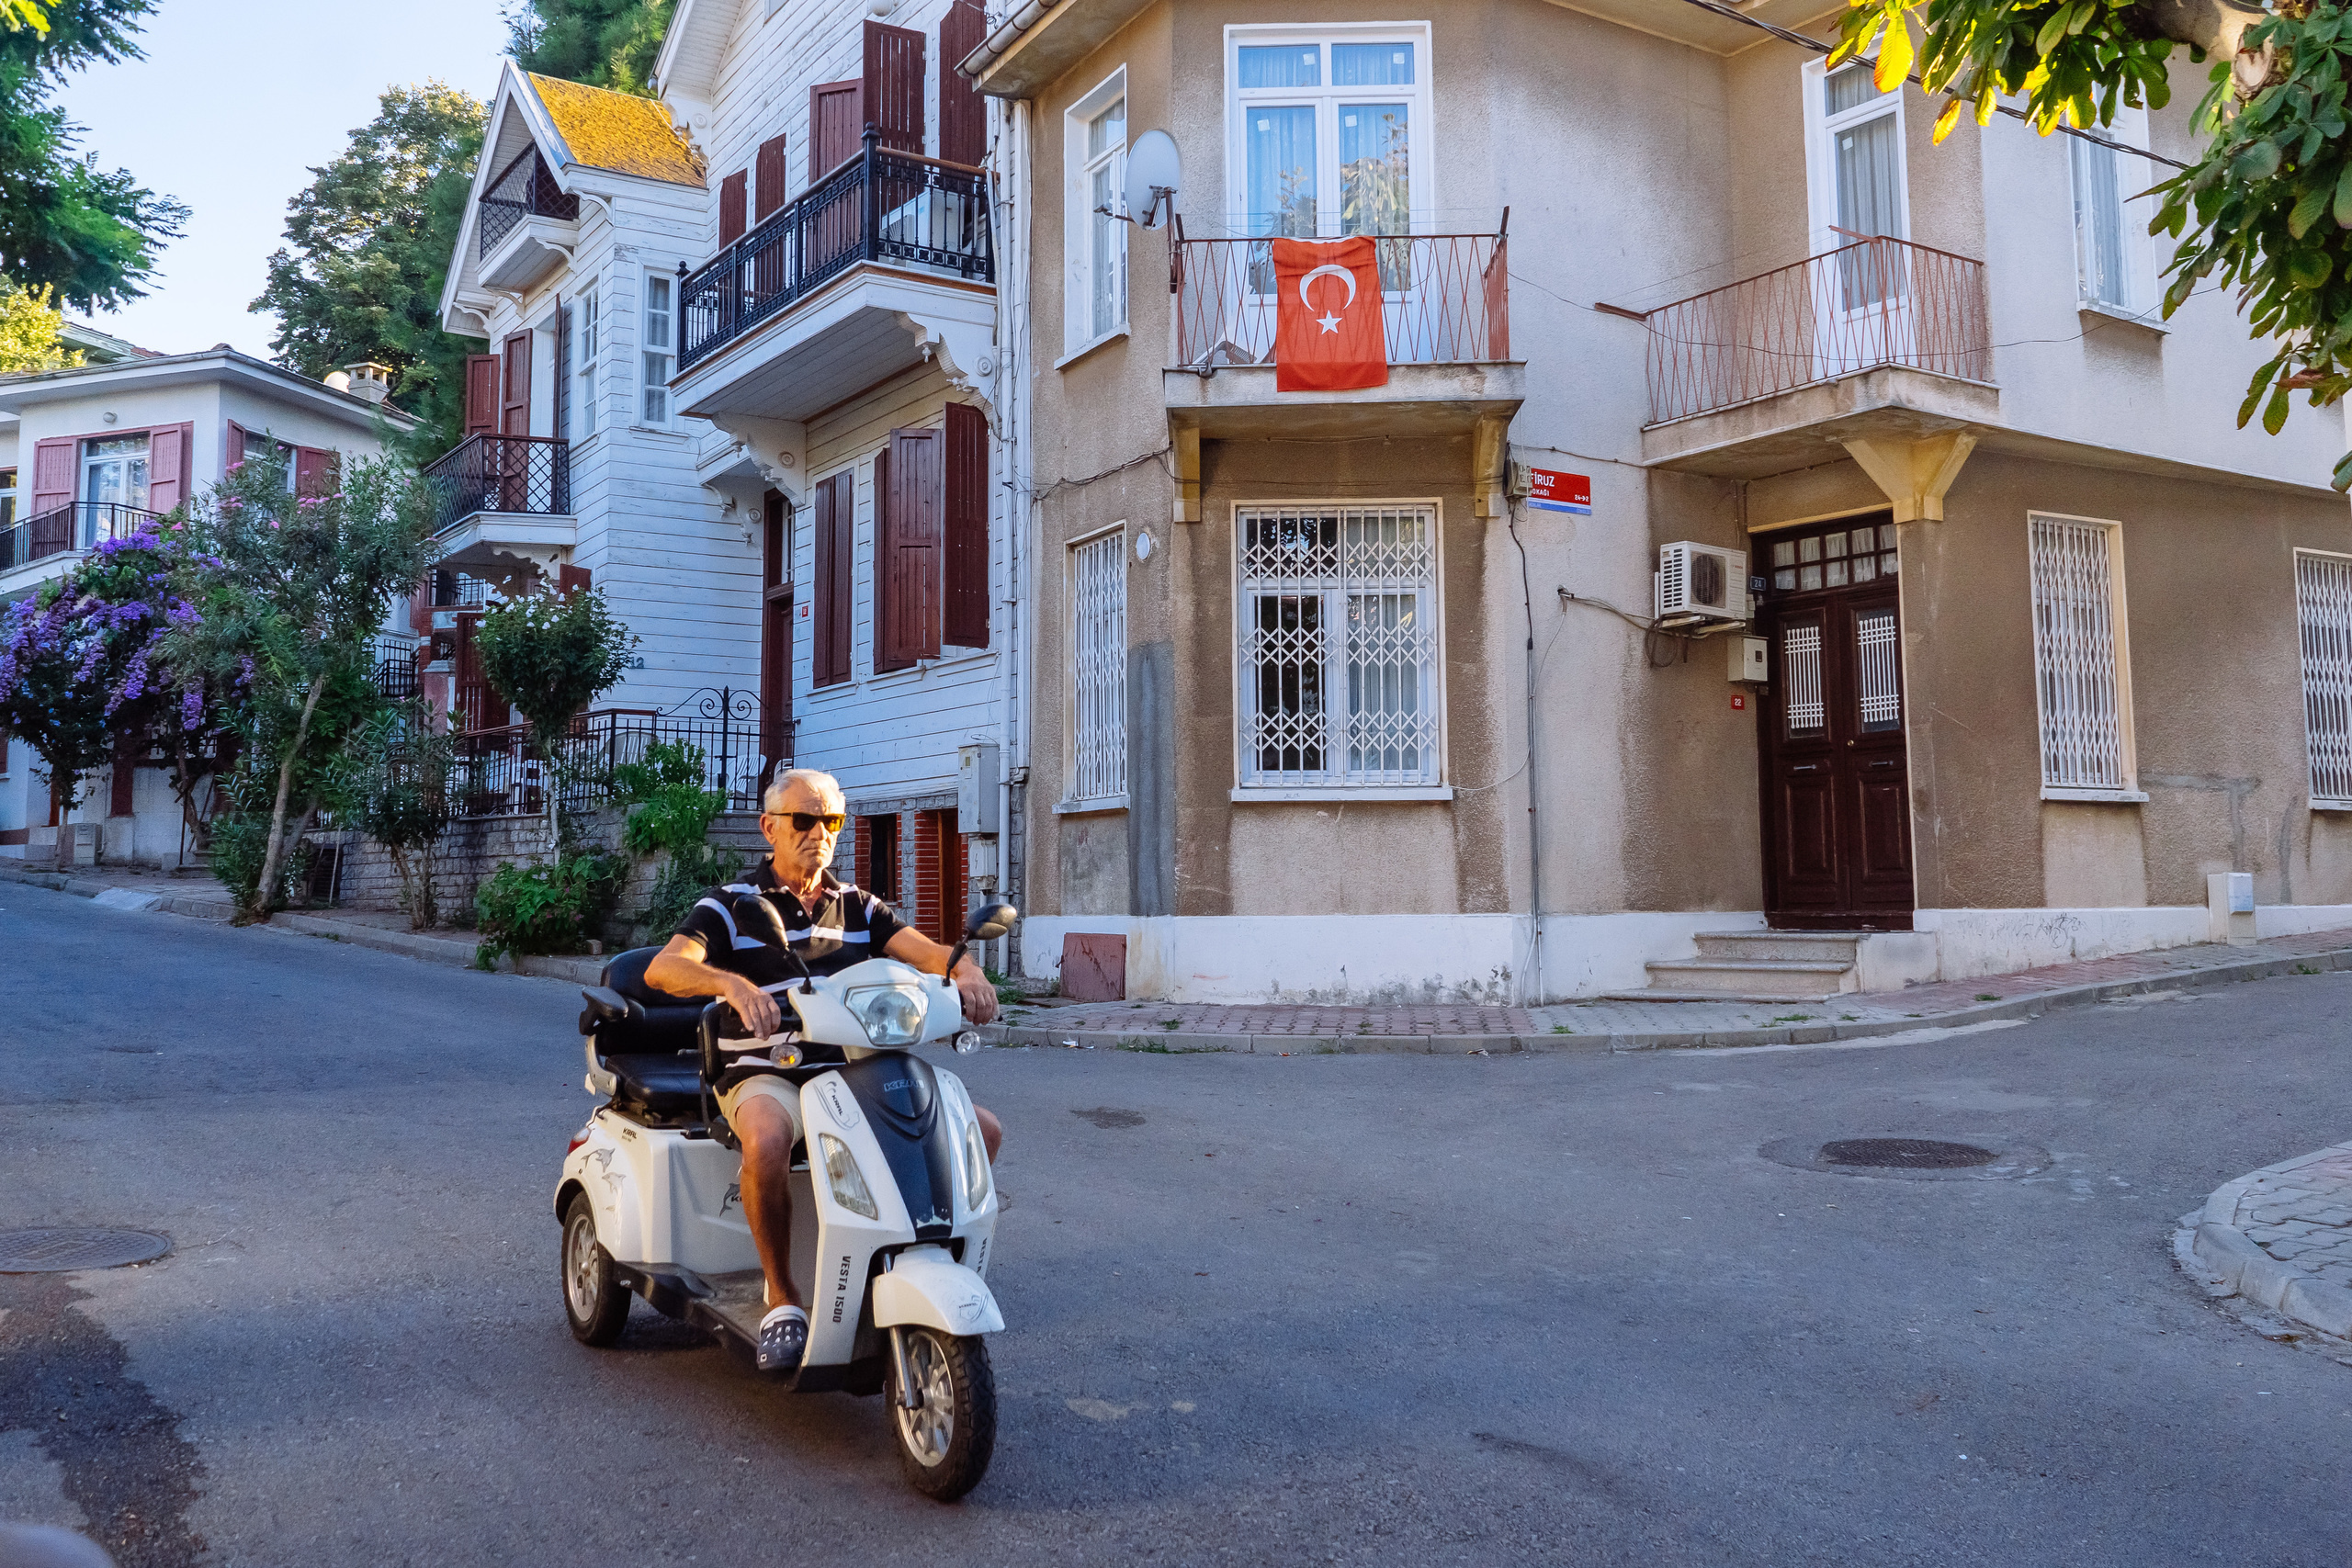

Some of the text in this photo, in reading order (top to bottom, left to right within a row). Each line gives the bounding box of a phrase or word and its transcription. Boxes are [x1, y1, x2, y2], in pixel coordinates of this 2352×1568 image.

[1754, 579, 1762, 588] 24
[1734, 698, 1742, 706] 22
[831, 1094, 843, 1116] KRAL
[832, 1256, 851, 1324] VESTA 1500
